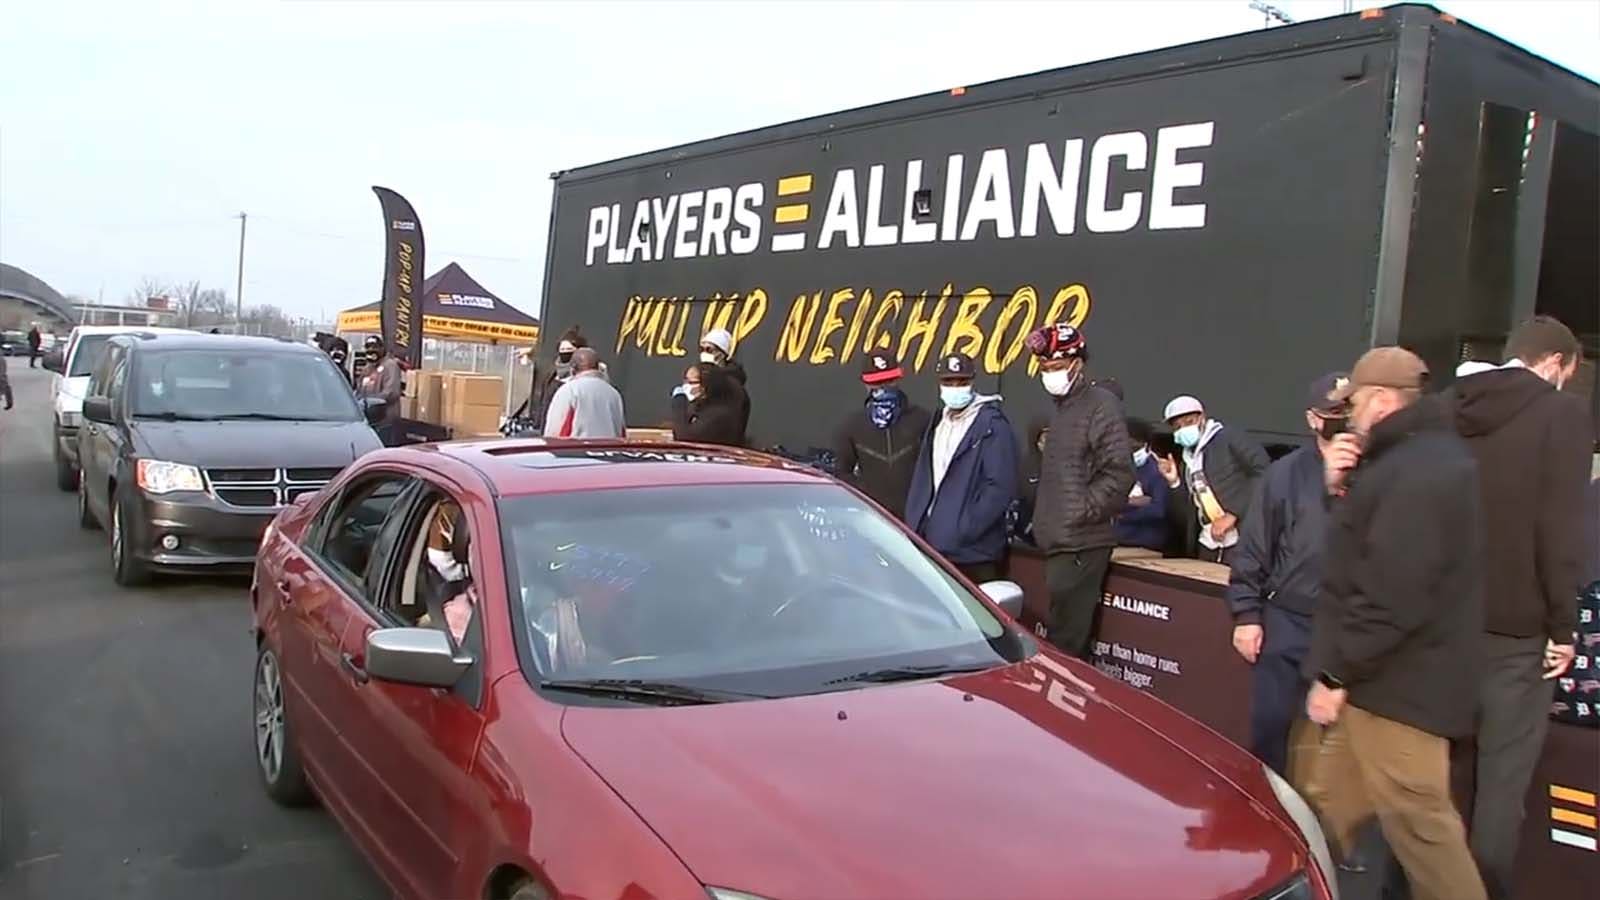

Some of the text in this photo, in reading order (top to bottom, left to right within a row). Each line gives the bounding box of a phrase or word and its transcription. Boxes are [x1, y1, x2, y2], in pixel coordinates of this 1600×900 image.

[585, 121, 1214, 266] PLAYERS ALLIANCE
[616, 295, 695, 357] PULL
[1112, 595, 1169, 620] ALLIANCE
[1112, 642, 1131, 661] than
[1133, 647, 1157, 668] home
